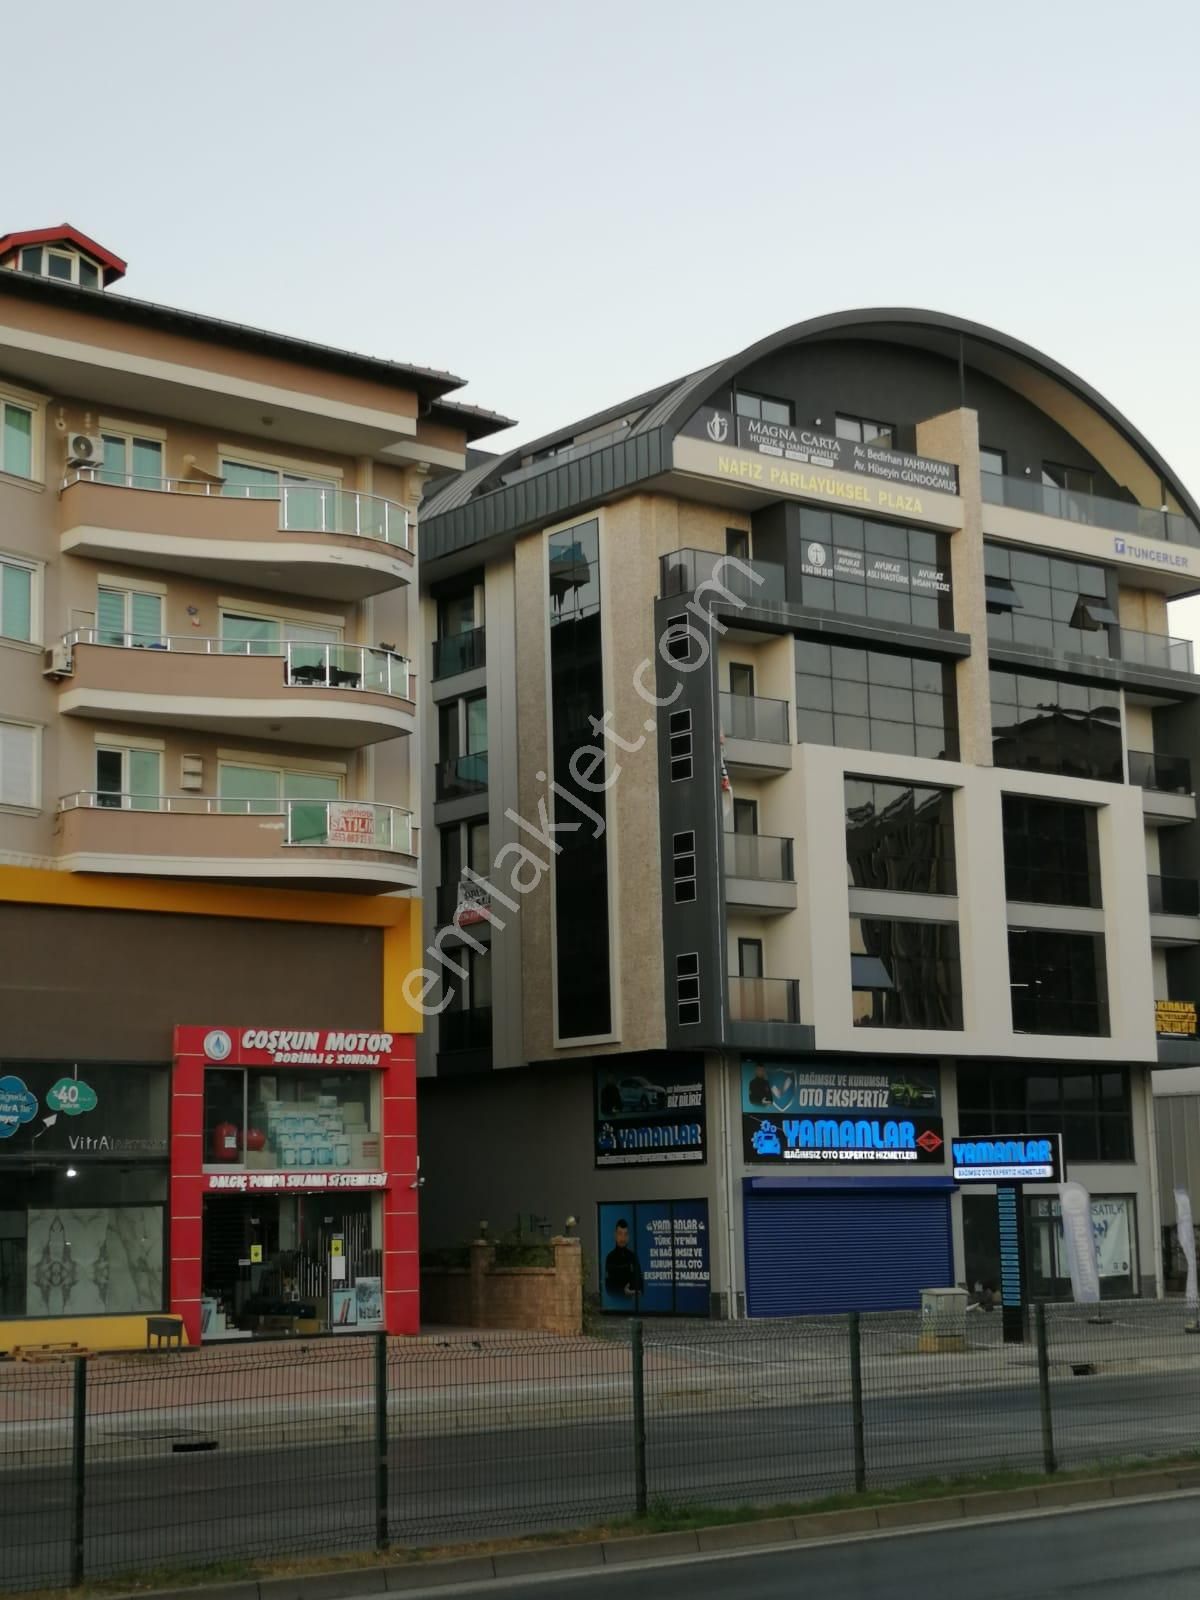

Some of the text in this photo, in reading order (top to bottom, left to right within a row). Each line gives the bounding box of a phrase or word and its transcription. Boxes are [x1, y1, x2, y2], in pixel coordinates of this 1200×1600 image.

[748, 420, 798, 442] MAGNA
[801, 431, 841, 452] CARTA
[853, 446, 949, 476] Av. Bedirhan KAHRAMAN
[868, 462, 900, 479] Hüseyin
[878, 491, 923, 514] PLAZA
[874, 561, 901, 572] AVUKAT
[918, 569, 944, 581] AVUKAT
[242, 1030, 393, 1054] COŞKUN MOTOR
[336, 1053, 380, 1065] SONDAJ
[799, 1072, 889, 1088] BAĞIMSIZ VE KURUMSAL
[800, 1087, 889, 1109] OTO EKSPERTİZ
[617, 1124, 702, 1149] YAMANLAR
[782, 1119, 916, 1149] YAMANLAR
[68, 1135, 110, 1150] VitrA
[822, 1151, 838, 1159] OTO
[953, 1139, 1053, 1164] YAMANLAR
[652, 1219, 698, 1230] YAMANLAR
[693, 1248, 702, 1257] VE
[688, 1260, 703, 1269] OTO
